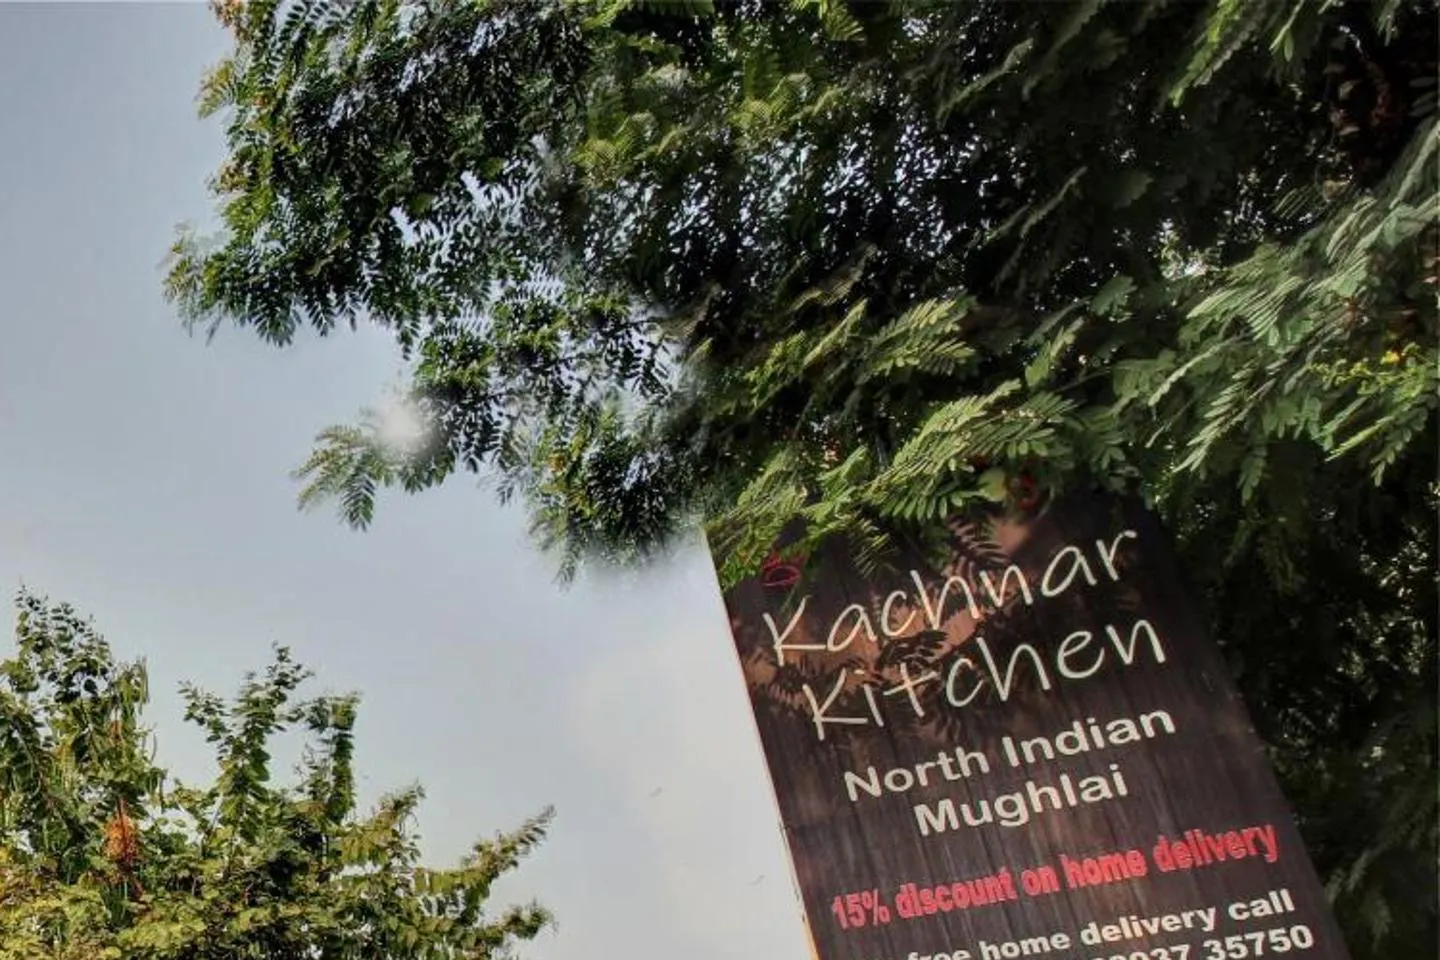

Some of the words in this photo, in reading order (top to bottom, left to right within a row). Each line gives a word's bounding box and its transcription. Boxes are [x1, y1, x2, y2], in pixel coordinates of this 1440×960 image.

[762, 529, 1138, 667] Kachnar
[802, 619, 1166, 741] Kitchen
[843, 746, 990, 801] North
[1001, 709, 1176, 767] Indian
[914, 764, 1128, 836] Mughlai
[832, 888, 891, 929] 15%
[895, 866, 1018, 919] discount
[1021, 865, 1060, 896] on
[1060, 849, 1148, 889] home
[1153, 825, 1279, 872] delivery
[1080, 907, 1217, 946] delivery
[1228, 888, 1295, 921] call
